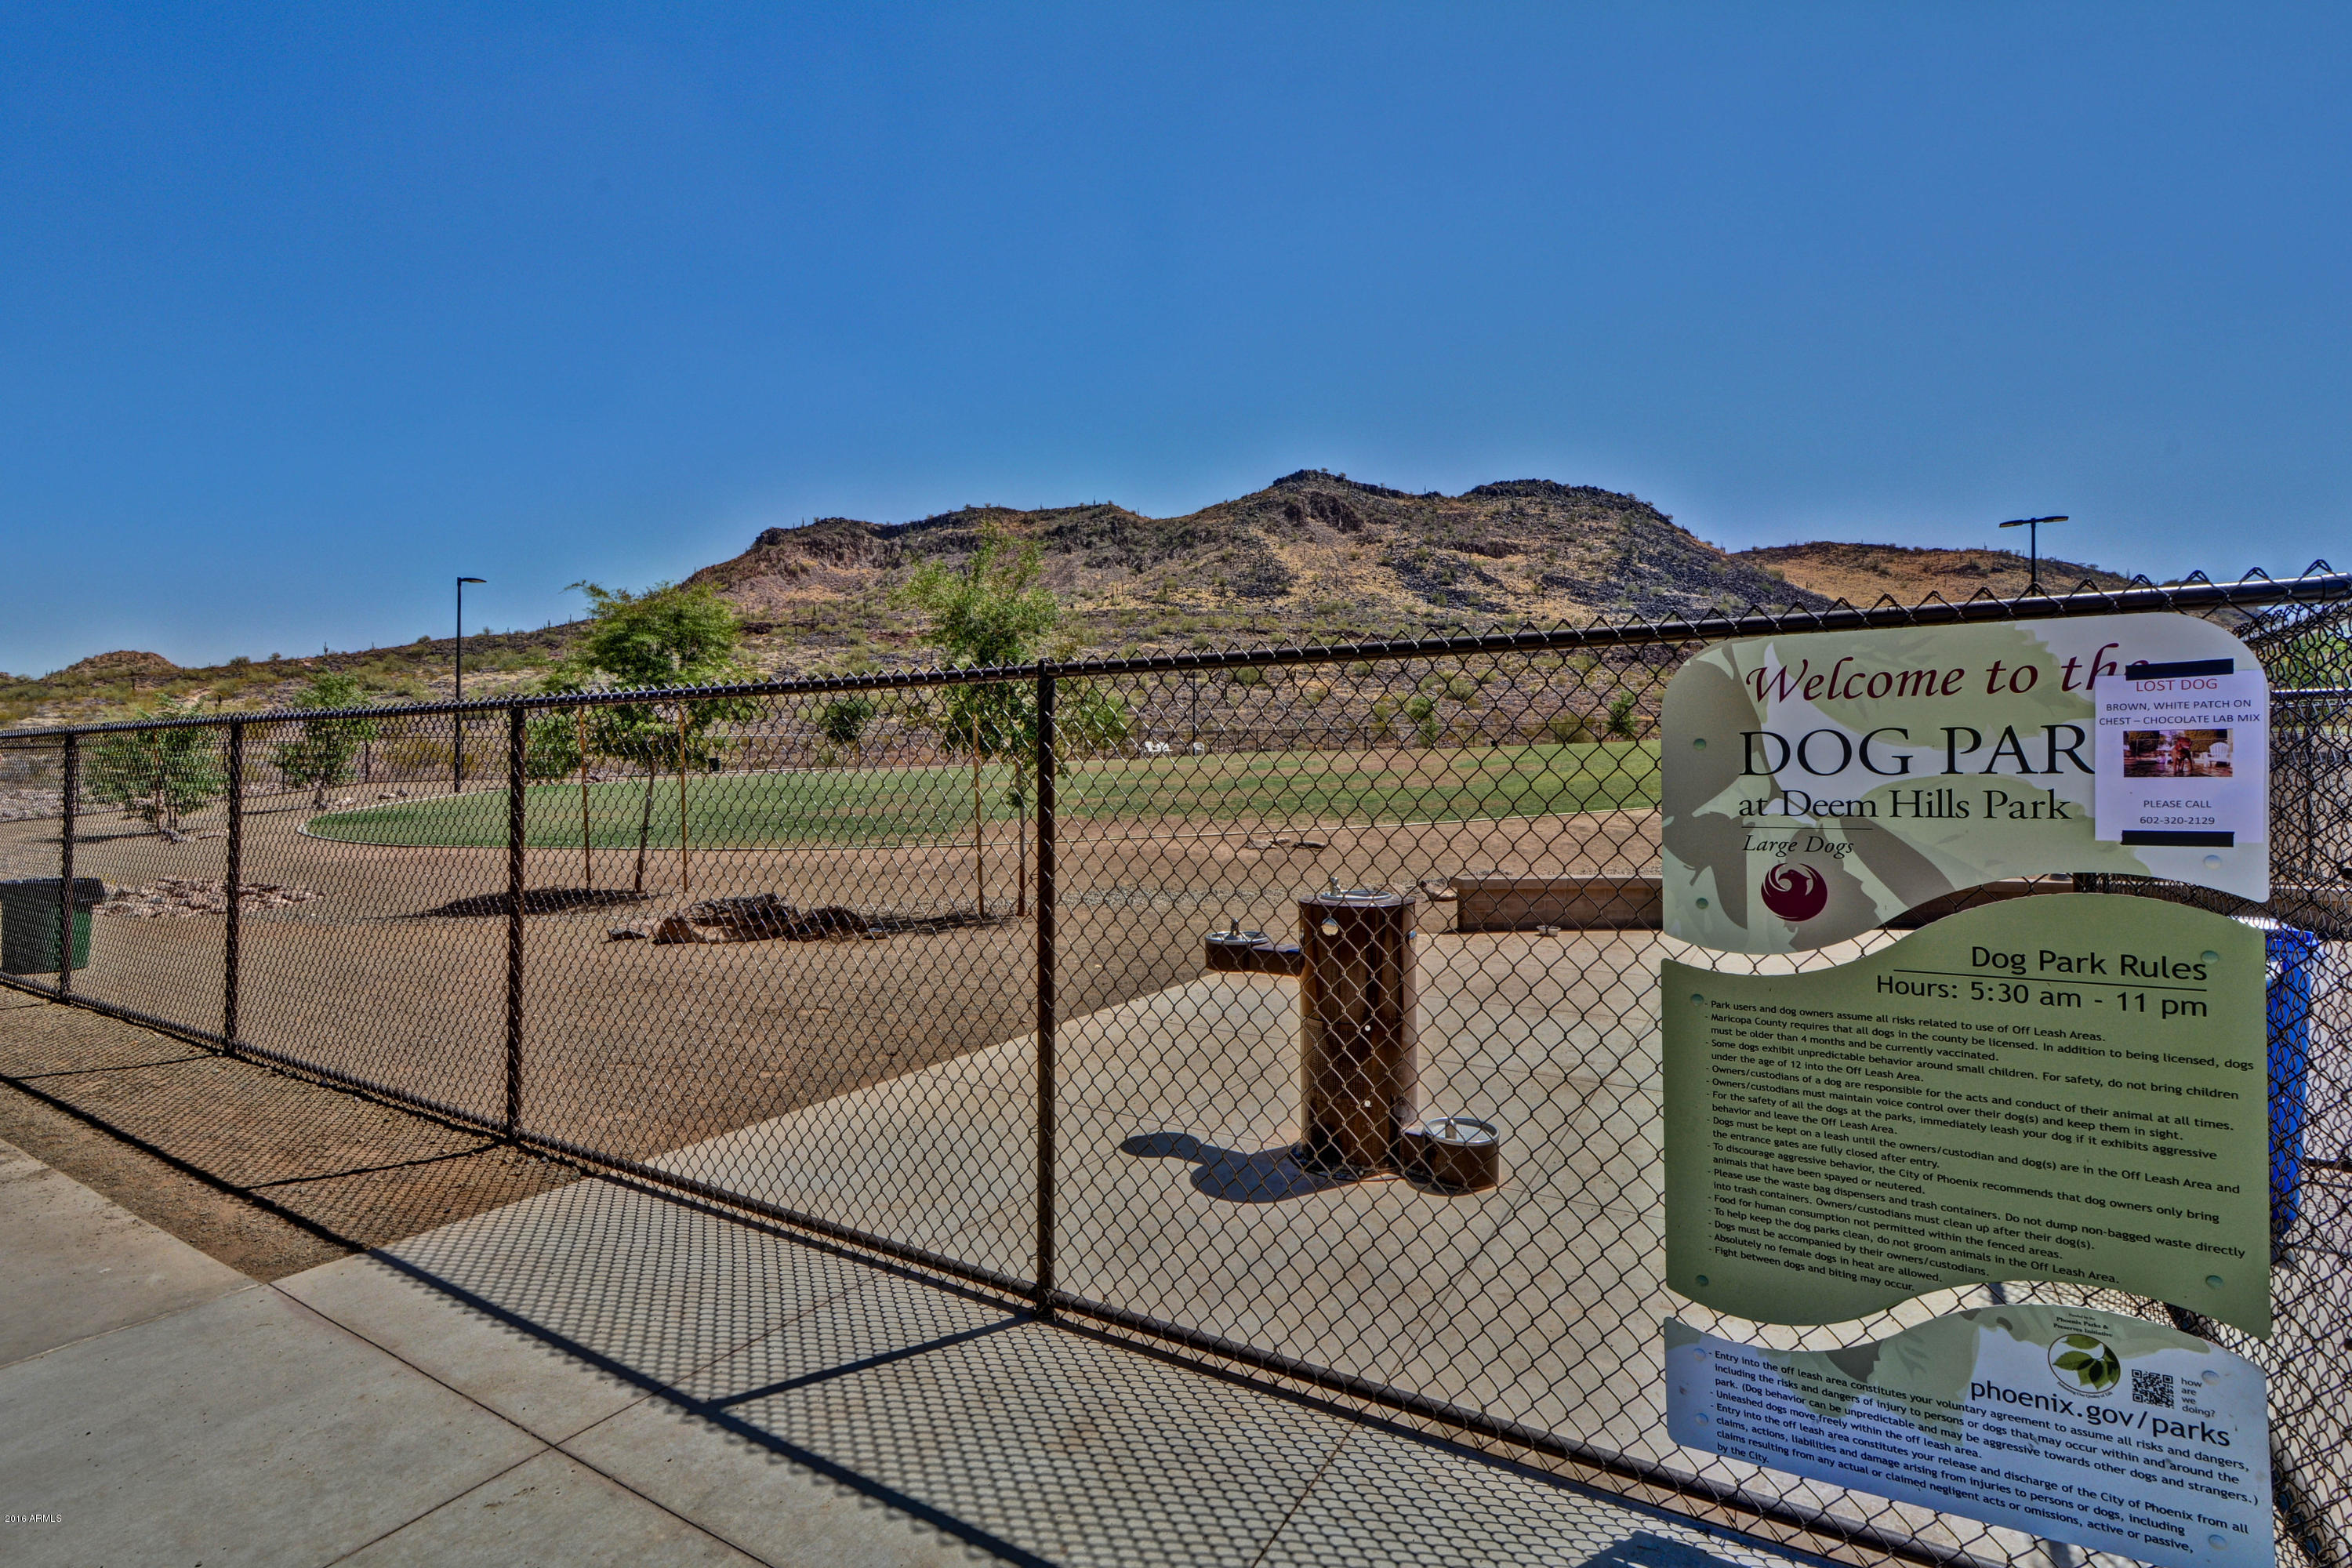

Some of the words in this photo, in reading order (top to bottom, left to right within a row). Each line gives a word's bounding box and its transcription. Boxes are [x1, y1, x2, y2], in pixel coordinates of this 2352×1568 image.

[1746, 656, 1965, 703] Welcome
[1986, 660, 2038, 694] to
[2061, 643, 2149, 691] th
[2136, 680, 2175, 691] LOST
[2181, 678, 2218, 691] DOG
[2099, 717, 2132, 725] CHEST
[2143, 715, 2209, 724] CHOCOLATE
[2213, 714, 2234, 723] LAB
[2238, 713, 2260, 722] MIX
[2106, 702, 2150, 711] BROWN,
[2154, 701, 2190, 710] WHITE
[2194, 700, 2229, 709] PATCH
[1739, 728, 1913, 775] DOG
[1940, 724, 2095, 775] PAR
[1739, 797, 1768, 816] at
[1780, 789, 1878, 818] Deem
[1889, 788, 1969, 818] Hills
[1983, 788, 2072, 819] Park
[2143, 800, 2182, 808] PLEASE
[2185, 800, 2212, 808] CALL
[2140, 816, 2215, 825] 602-320-2129
[1743, 834, 1798, 857] Large
[1804, 836, 1854, 859] Dogs
[1972, 946, 2027, 975] Dog
[2038, 949, 2107, 975] Park
[2120, 954, 2208, 981] Rules
[1877, 975, 1958, 999] Hours:
[1970, 981, 2030, 1004] 5:30
[2039, 990, 2082, 1007] am
[2117, 991, 2145, 1013] 11
[2161, 998, 2208, 1019] pm
[1711, 1000, 1730, 1010] Park
[1779, 1006, 1797, 1017] dog
[1799, 1010, 1834, 1018] owners
[1836, 1013, 1873, 1022] assume
[1876, 1014, 1889, 1023] all
[1892, 1016, 1915, 1025] risks
[1918, 1018, 1957, 1029] related
[1961, 1022, 1973, 1030] to
[1997, 1025, 2009, 1033] of
[2013, 1025, 2031, 1035] Off
[2034, 1027, 2067, 1038] Leash
[2069, 1030, 2106, 1041] Areas.
[1711, 1013, 1751, 1025] Maricopa
[1755, 1018, 1788, 1029] County
[1790, 1022, 1830, 1031] requires
[1832, 1024, 1853, 1033] that
[1856, 1026, 1868, 1035] all
[1871, 1028, 1895, 1039] dogs
[1898, 1030, 1907, 1039] in
[1911, 1031, 1929, 1040] the
[1932, 1035, 1968, 1046] county
[1972, 1036, 1985, 1046] be
[1989, 1037, 2038, 1051] licensed.
[2043, 1043, 2053, 1051] In
[2057, 1044, 2105, 1056] addition
[2110, 1049, 2122, 1058] to
[2126, 1050, 2159, 1063] being
[2163, 1053, 2219, 1069] licensed,
[2224, 1058, 2254, 1072] dogs
[1736, 1029, 1747, 1037] be
[1750, 1030, 1774, 1039] older
[1777, 1033, 1798, 1042] than
[1809, 1037, 1846, 1047] months
[1870, 1041, 1882, 1050] be
[1886, 1044, 1933, 1056] currently
[1936, 1049, 1999, 1061] vaccinated.
[1712, 1130, 1728, 1138] the
[1730, 1134, 1771, 1145] entrance
[1773, 1139, 1799, 1149] gates
[1820, 1144, 1843, 1156] fully
[1846, 1148, 1878, 1160] closed
[1881, 1153, 1907, 1163] after
[1910, 1158, 1940, 1169] entry.
[1715, 1220, 1736, 1232] Dogs
[1738, 1226, 1761, 1236] must
[1763, 1229, 1775, 1238] be
[1778, 1233, 1841, 1250] accompanied
[1844, 1243, 1857, 1254] by
[1859, 1246, 1884, 1257] their
[1886, 1252, 1989, 1276] owners/custodians.
[2053, 1323, 2082, 1333] Preserves
[2084, 1328, 2113, 1338] Initiative
[2056, 1316, 2082, 1325] Phoenix
[2181, 1377, 2202, 1388] how
[1715, 1350, 1739, 1364] Entry
[1741, 1356, 1760, 1367] into
[1762, 1362, 1778, 1372] the
[1781, 1367, 1795, 1375] off
[1798, 1369, 1823, 1381] leash
[1825, 1377, 1848, 1387] area
[1850, 1377, 1907, 1399] constitutes
[1910, 1394, 1933, 1405] your
[1936, 1399, 1987, 1417] voluntary
[1990, 1411, 2051, 1429] agreement
[2054, 1423, 2067, 1432] to
[2071, 1428, 2114, 1442] assume
[2117, 1436, 2132, 1446] all
[2136, 1439, 2164, 1452] risks
[2167, 1447, 2190, 1458] and
[2194, 1451, 2249, 1472] dangers,
[1971, 1380, 2231, 1447] phoenix.gov/parks
[2181, 1396, 2196, 1405] we
[2182, 1405, 2216, 1418] doing?
[1715, 1363, 1756, 1381] including
[1759, 1374, 1774, 1384] the
[1777, 1378, 1798, 1389] risks
[1801, 1385, 1819, 1394] and
[1821, 1388, 1860, 1403] dangers
[1877, 1399, 1907, 1415] injury
[1910, 1407, 1921, 1417] to
[1924, 1411, 1964, 1425] persons
[1982, 1422, 2007, 1436] dogs
[2011, 1428, 2035, 1442] that
[2038, 1434, 2061, 1448] may
[2065, 1441, 2098, 1454] occur
[2101, 1449, 2139, 1463] within
[2143, 1457, 2165, 1468] and
[2169, 1460, 2213, 1479] around
[2218, 1472, 2239, 1484] the
[1717, 1443, 1728, 1454] by
[1731, 1447, 1746, 1457] the
[1749, 1451, 1769, 1464] City.
